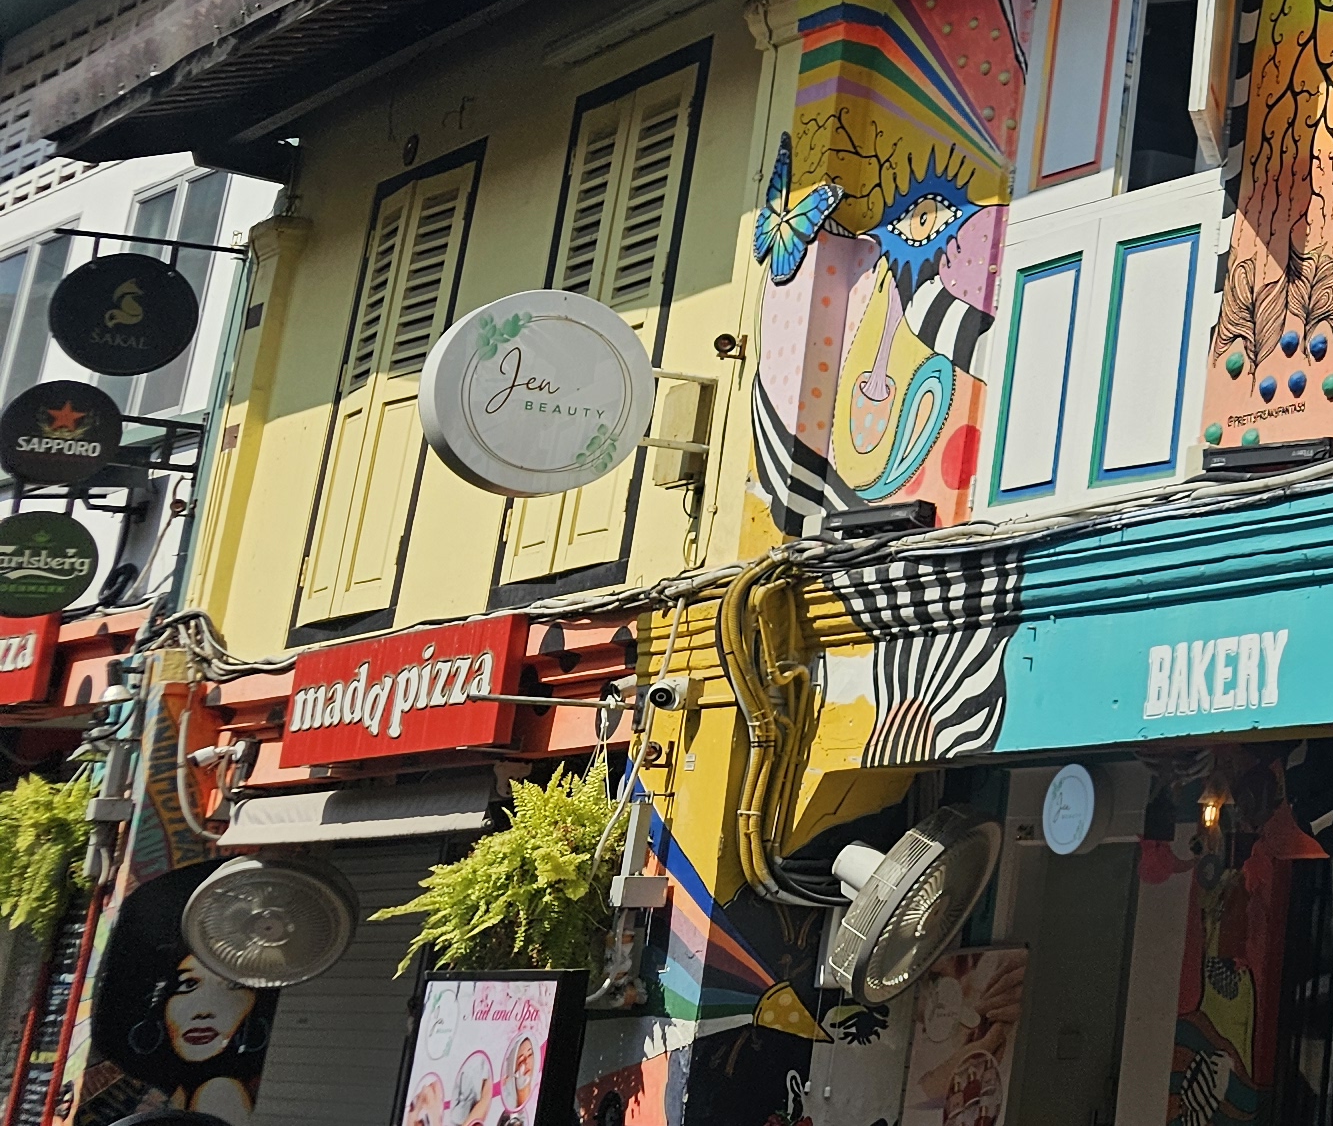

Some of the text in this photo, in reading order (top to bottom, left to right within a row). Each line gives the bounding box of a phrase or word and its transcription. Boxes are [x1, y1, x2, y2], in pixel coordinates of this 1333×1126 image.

[485, 347, 560, 414] Jen
[524, 400, 605, 419] BEAUTY
[16, 436, 101, 457] SAPPORO
[387, 643, 494, 739] pizza
[1143, 629, 1289, 720] BAKERY
[463, 999, 540, 1031] Nail and Spa
